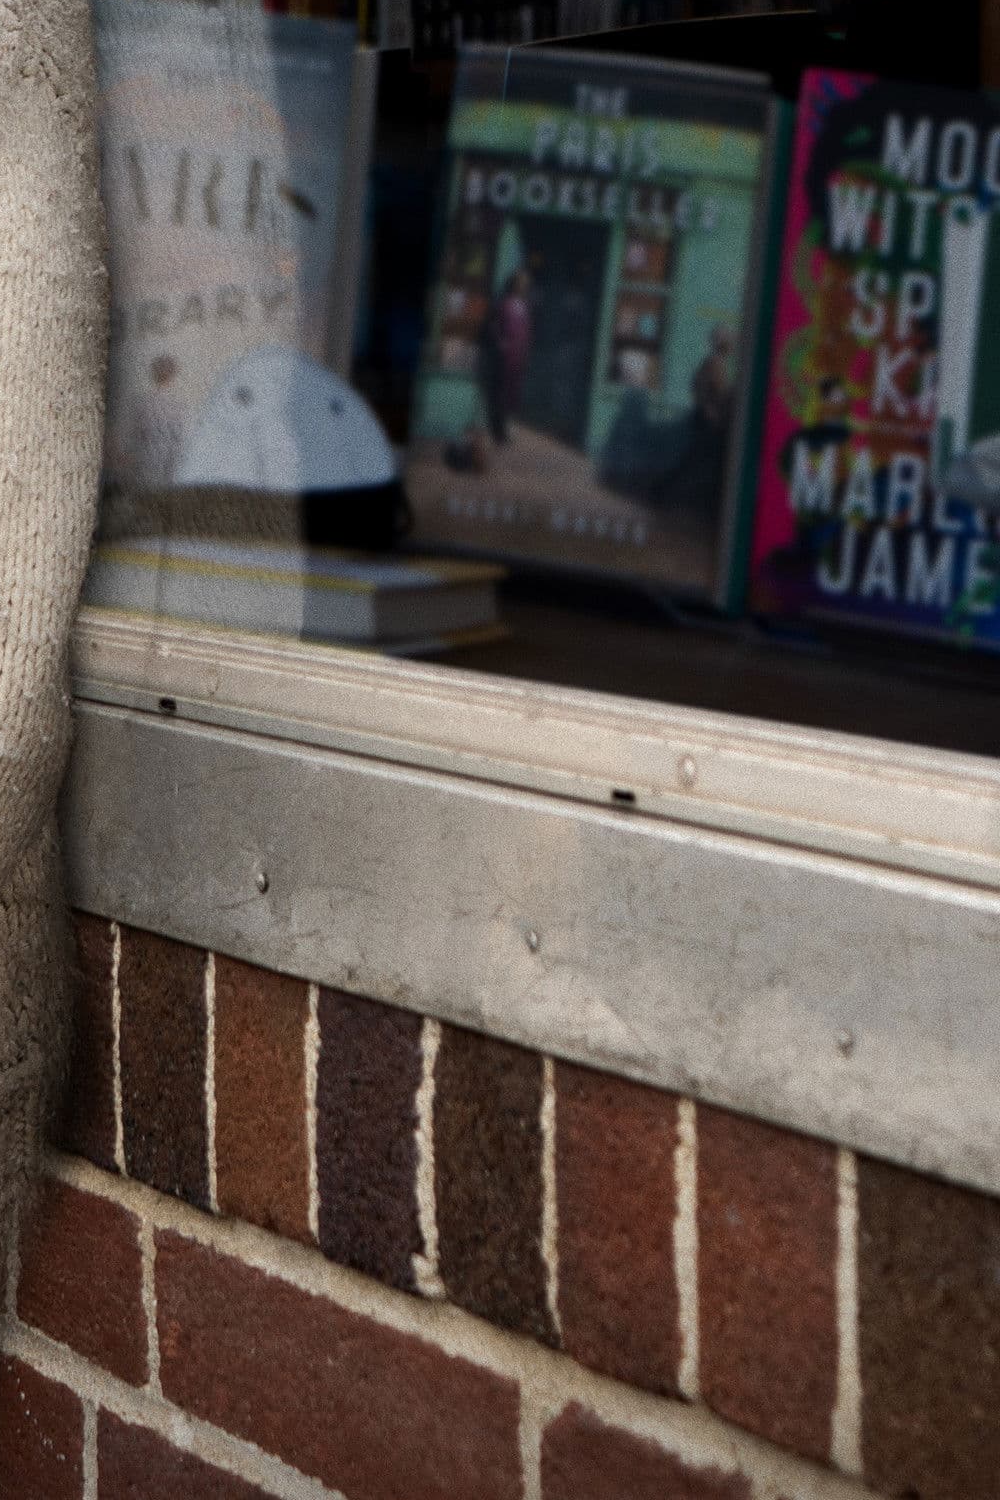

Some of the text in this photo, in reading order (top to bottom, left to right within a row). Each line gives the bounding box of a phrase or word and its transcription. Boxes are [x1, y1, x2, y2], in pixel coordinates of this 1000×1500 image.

[531, 116, 660, 178] PARIS
[827, 182, 976, 261] WIT
[848, 268, 936, 340] SP
[791, 438, 987, 536] MARL
